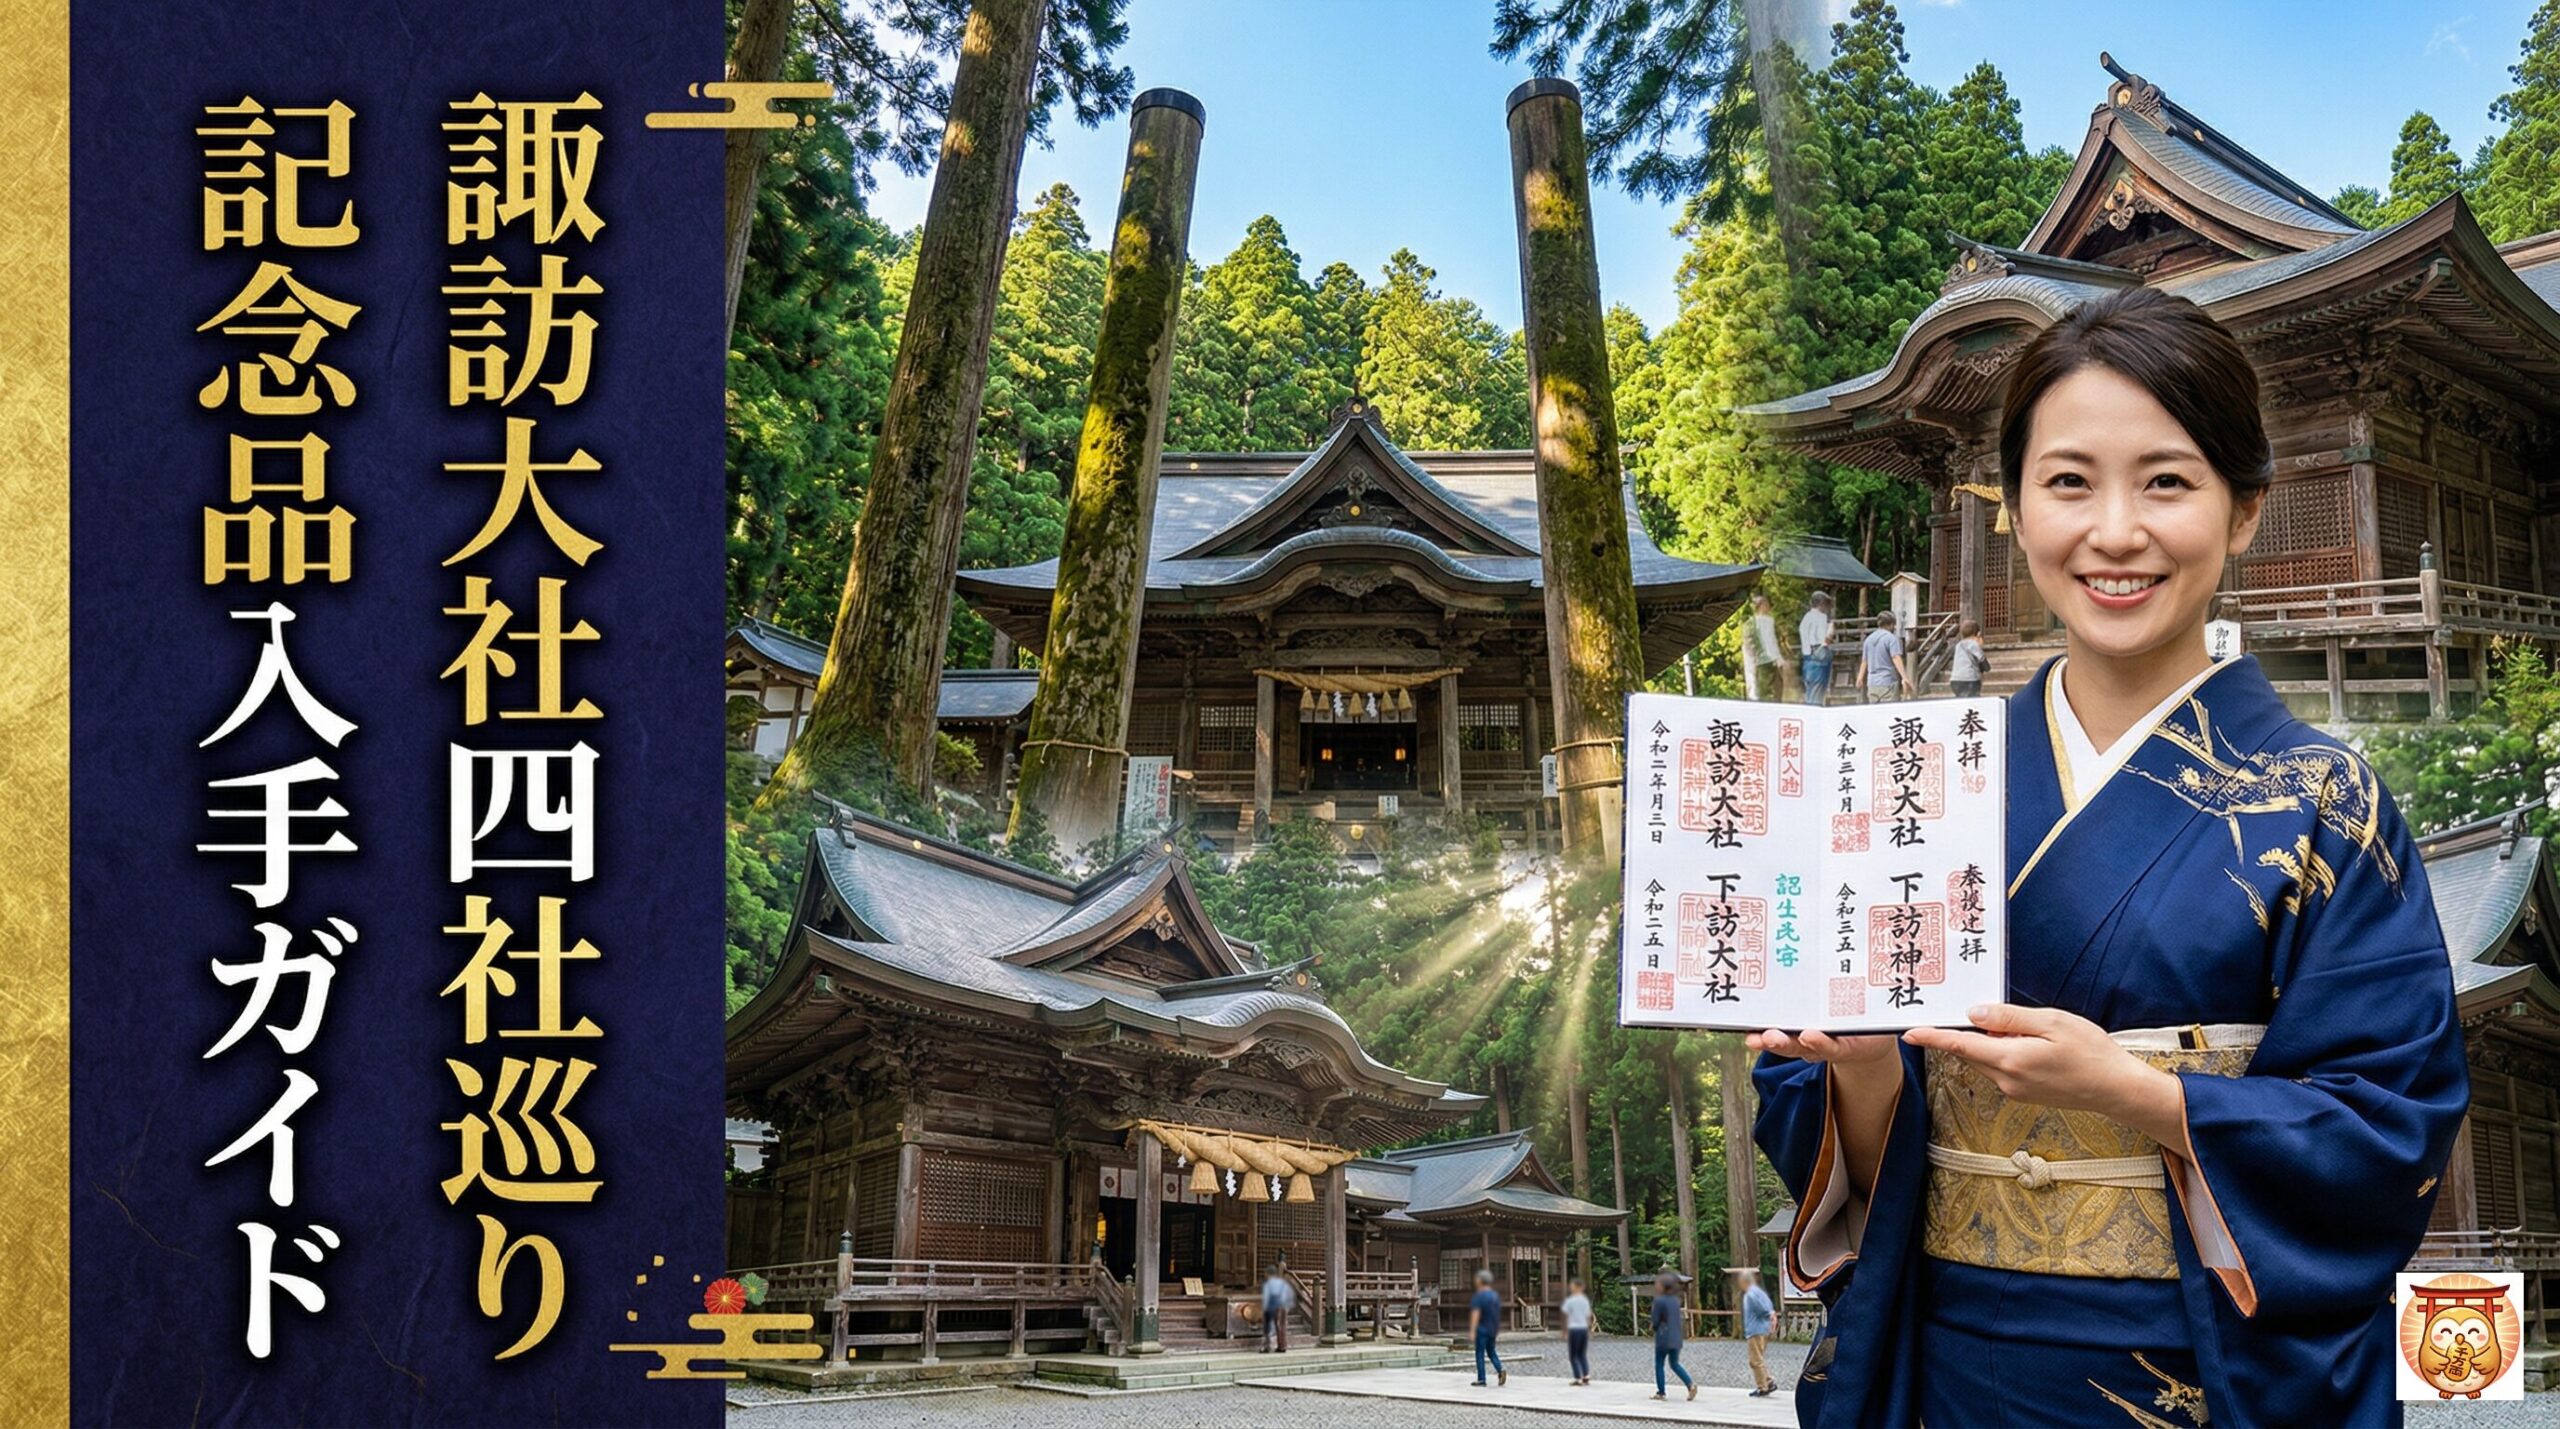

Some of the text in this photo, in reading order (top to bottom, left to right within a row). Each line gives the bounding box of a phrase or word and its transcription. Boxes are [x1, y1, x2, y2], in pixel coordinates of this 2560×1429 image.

[1648, 719, 1671, 844] 令和二年月三日
[1705, 718, 1748, 849] 諏訪大社
[1837, 722, 1857, 813] 令和三年月
[1889, 716, 1927, 849] 諏訪大社
[1957, 708, 1988, 770] 奉拝
[1643, 878, 1667, 969] 令和二五日
[1702, 873, 1742, 1004] 下訪大社
[1835, 882, 1857, 974] 令和三五日
[1887, 871, 1925, 1009] 下訪神社
